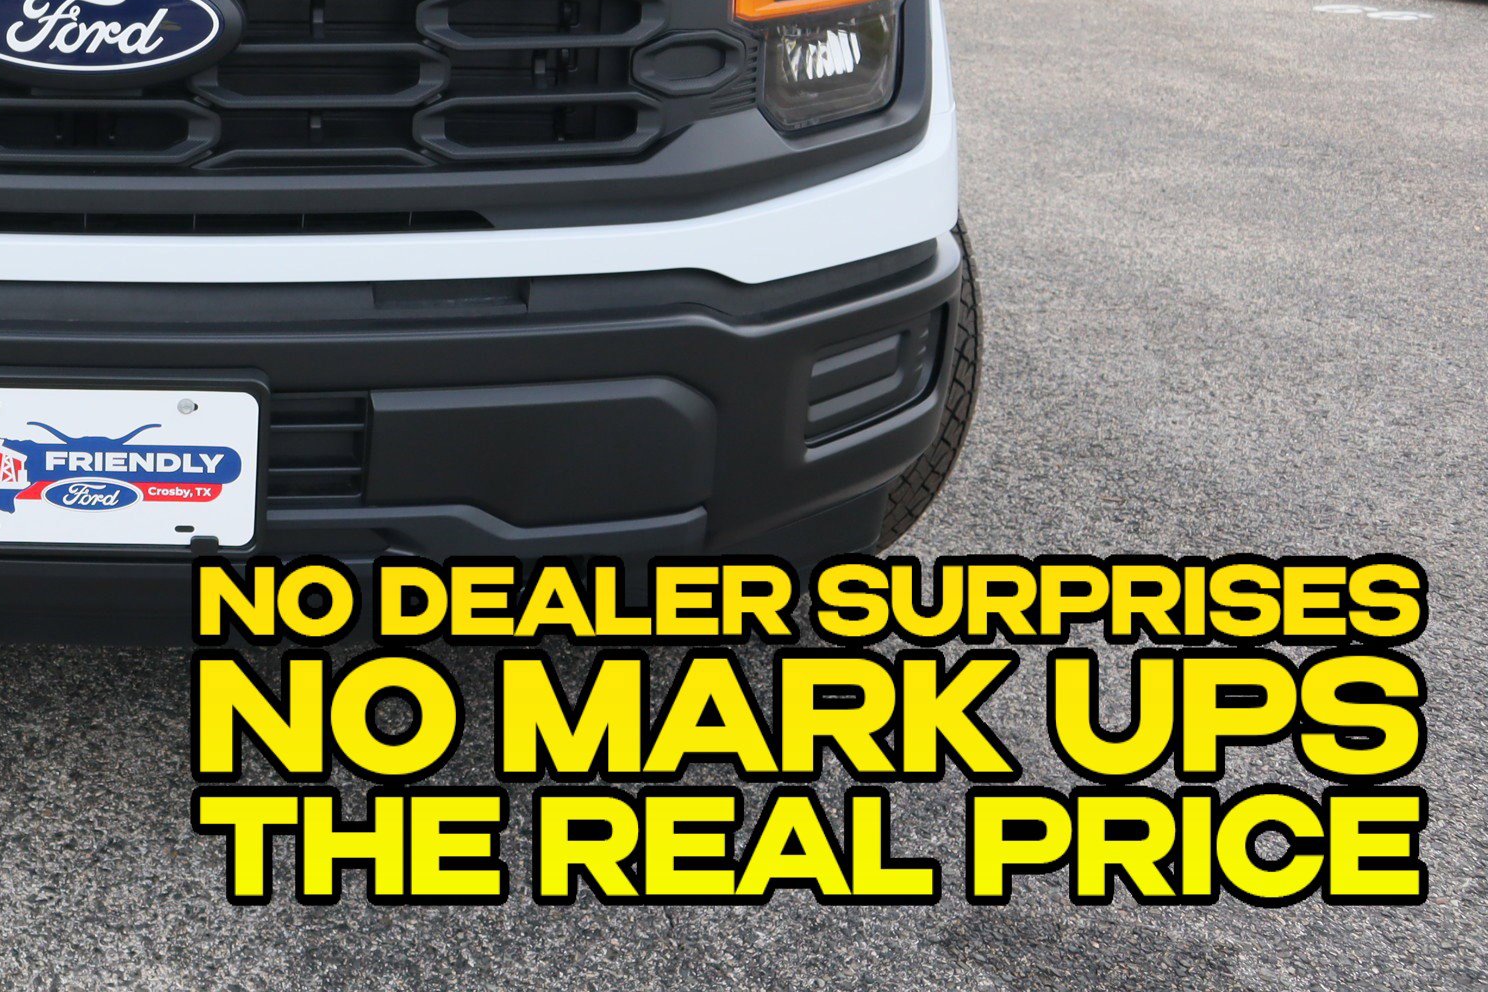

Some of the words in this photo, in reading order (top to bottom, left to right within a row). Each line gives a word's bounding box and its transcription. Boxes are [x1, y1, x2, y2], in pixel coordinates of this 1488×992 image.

[45, 450, 224, 474] FRIENDLY
[62, 482, 120, 507] Ford
[147, 486, 193, 499] Crosby,
[195, 487, 212, 497] TX
